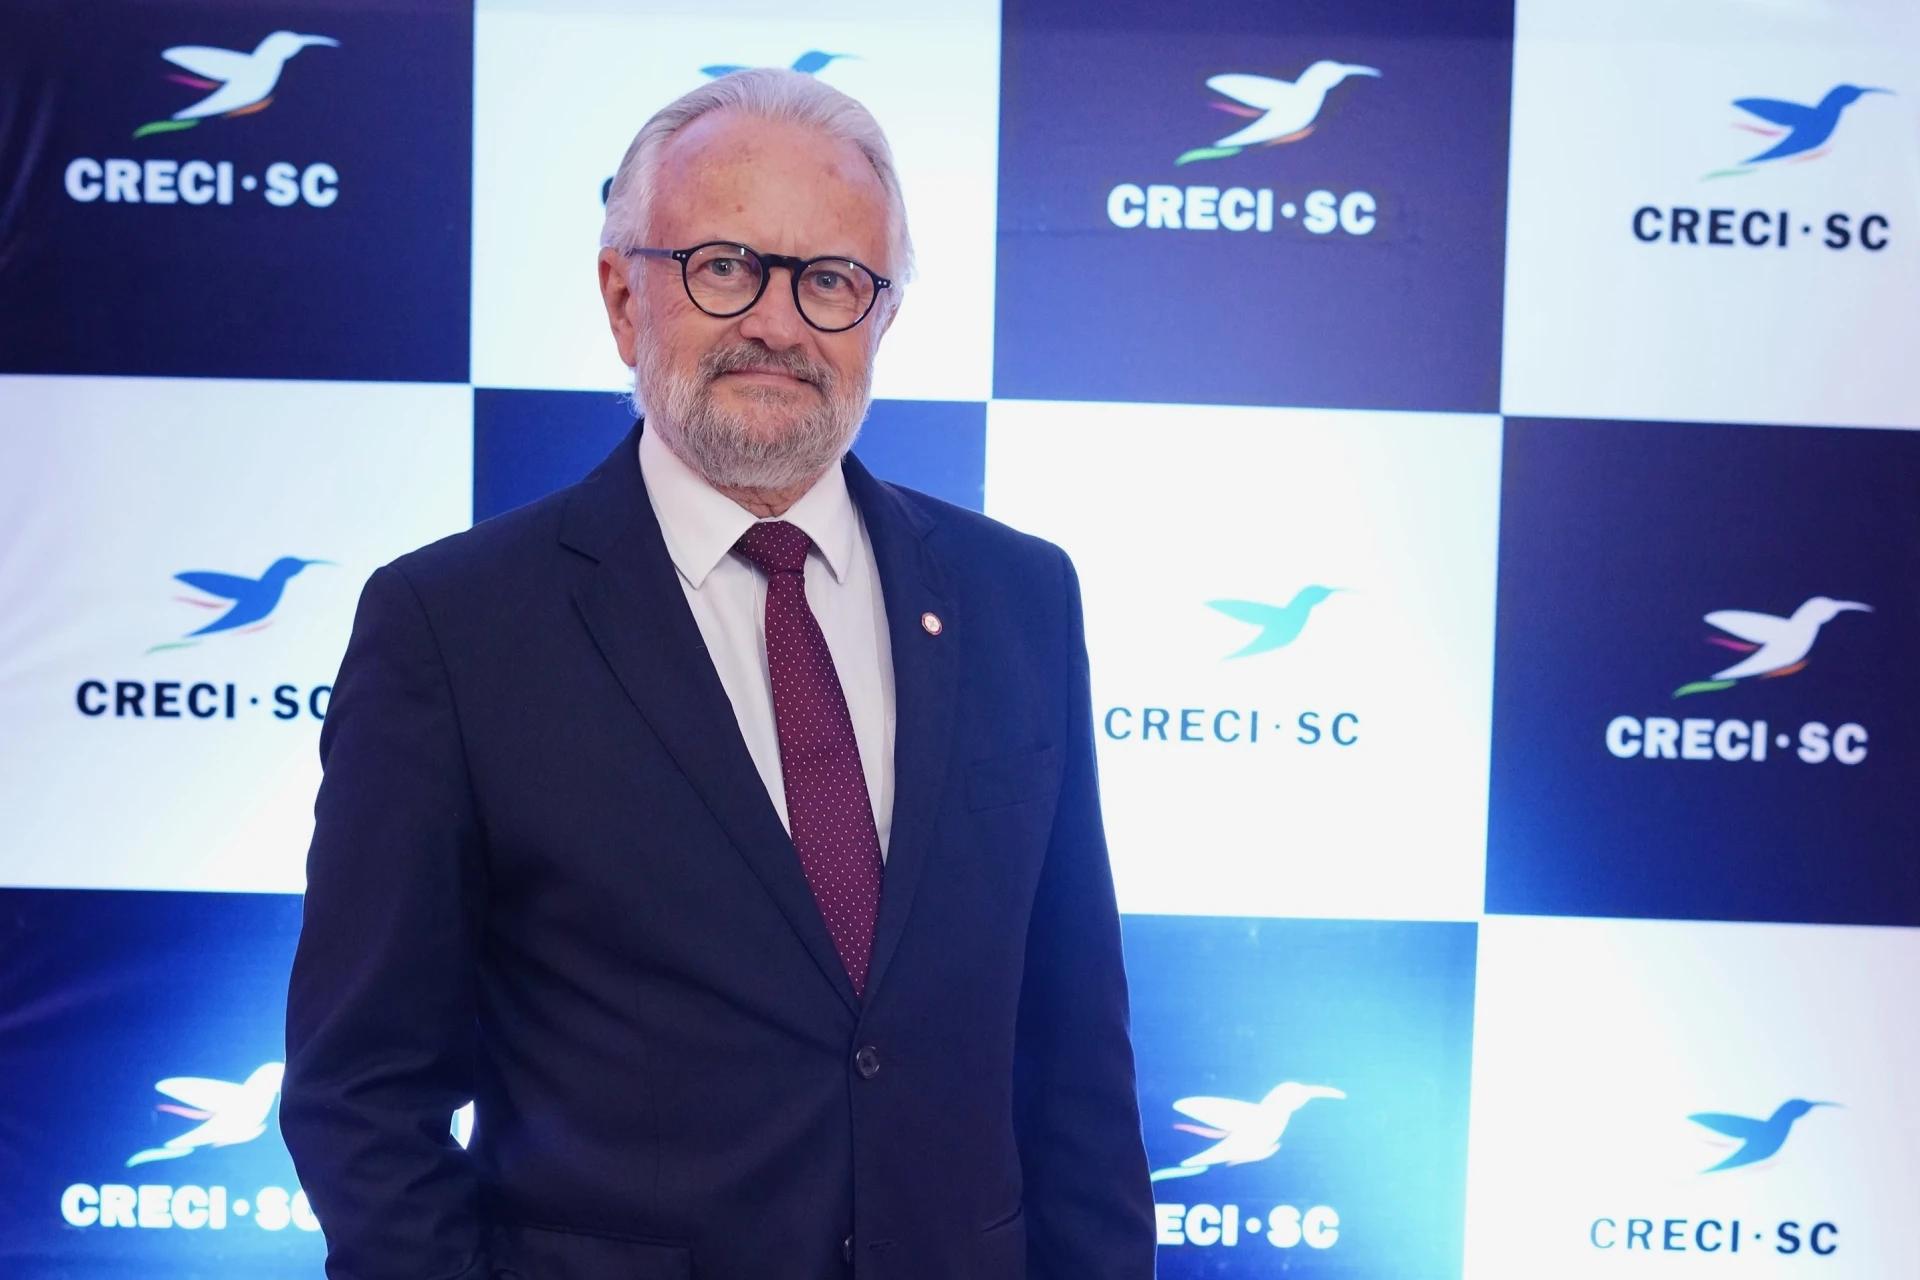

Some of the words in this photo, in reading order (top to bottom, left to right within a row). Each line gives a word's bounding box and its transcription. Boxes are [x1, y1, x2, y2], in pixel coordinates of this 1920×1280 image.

[64, 157, 234, 205] CRECI
[264, 162, 339, 207] SC
[1107, 183, 1274, 232] CRECI
[1303, 190, 1377, 235] SC
[1632, 205, 1788, 247] CRECI
[1824, 213, 1889, 251] SC
[76, 680, 236, 719] CRECI
[1103, 706, 1259, 743] CRECI
[1296, 711, 1359, 746] SC
[1605, 715, 1768, 762] CRECI
[1797, 721, 1868, 765] SC
[61, 1183, 227, 1230] CRECI
[1154, 1203, 1239, 1246] ECI
[1266, 1205, 1340, 1249] SC
[1589, 1217, 1740, 1253] CRECI
[1776, 1221, 1839, 1256] SC
